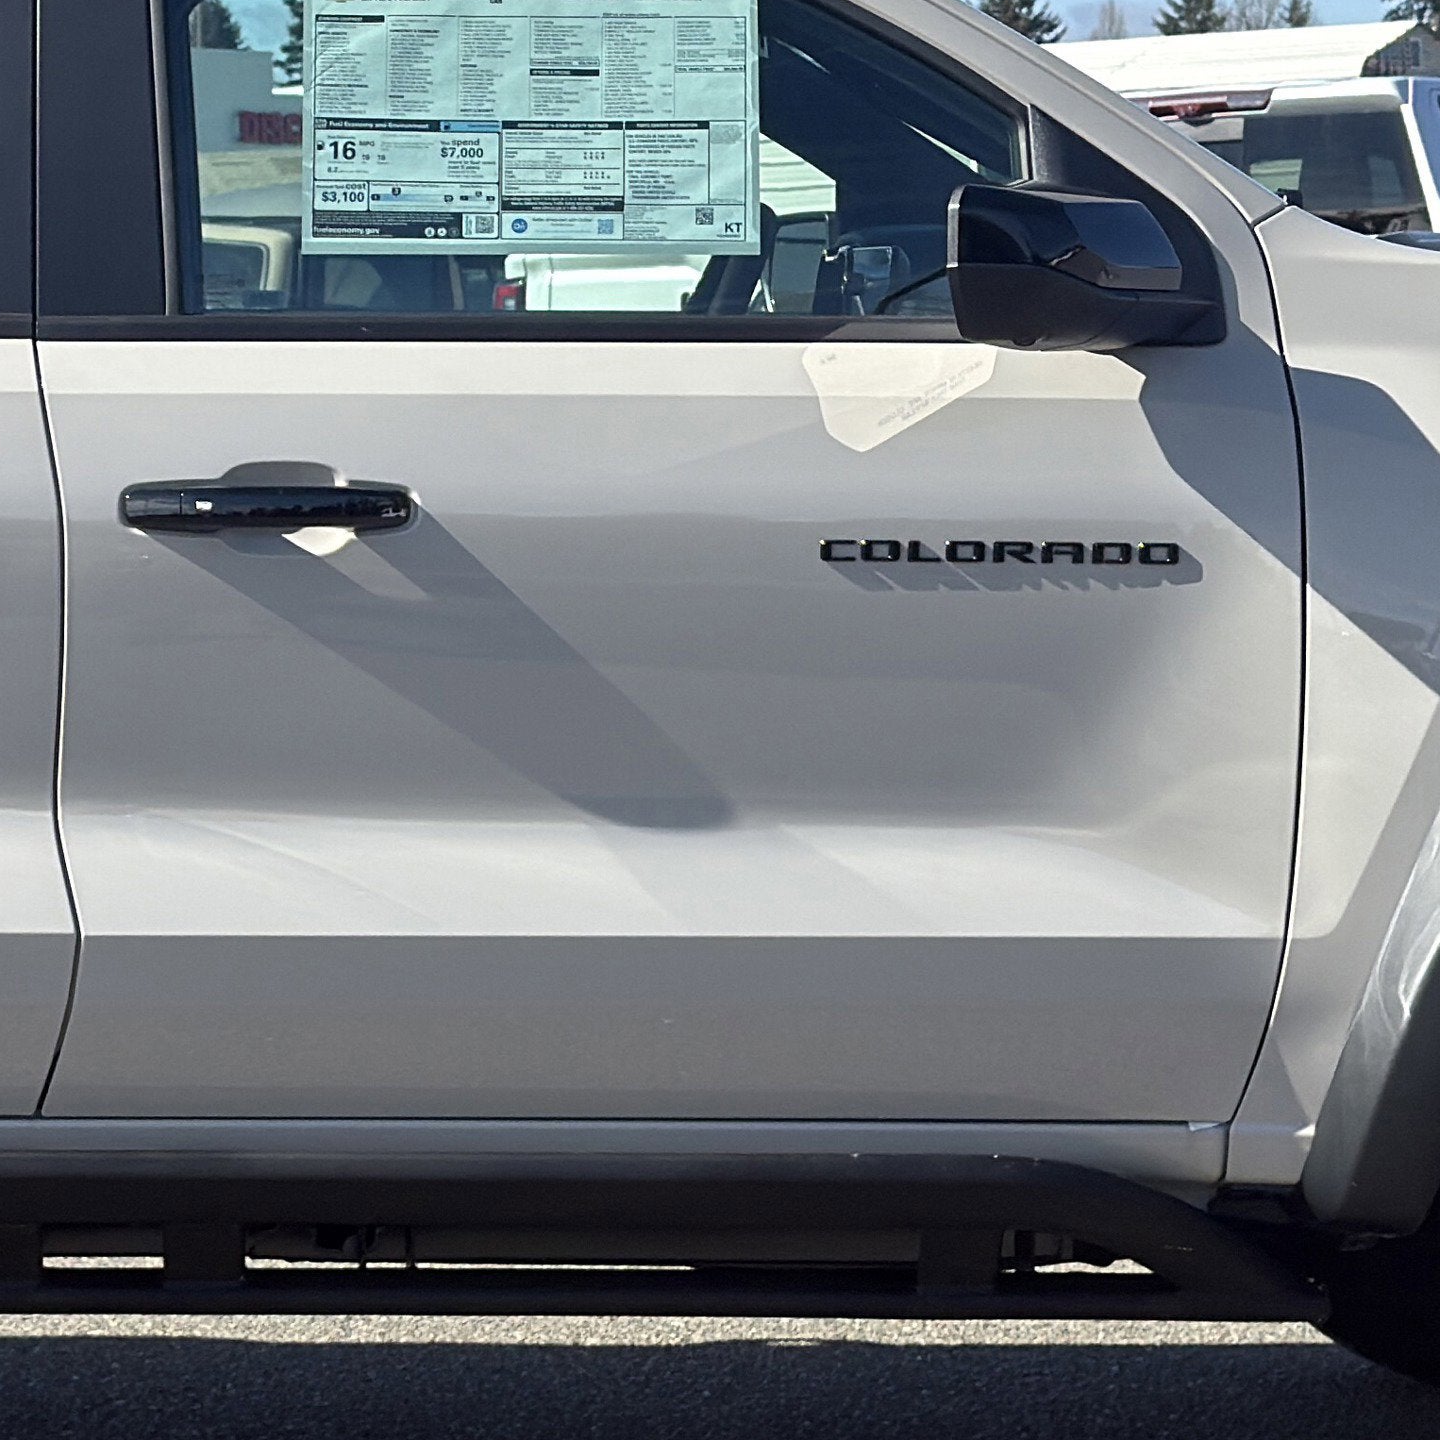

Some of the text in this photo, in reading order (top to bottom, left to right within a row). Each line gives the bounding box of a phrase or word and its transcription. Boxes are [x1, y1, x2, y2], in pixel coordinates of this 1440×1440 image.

[451, 138, 480, 147] spend
[328, 141, 356, 160] 16
[440, 147, 484, 159] $7,000
[321, 191, 365, 203] $3,100
[724, 223, 742, 233] KT
[819, 539, 1180, 565] COLORADO
